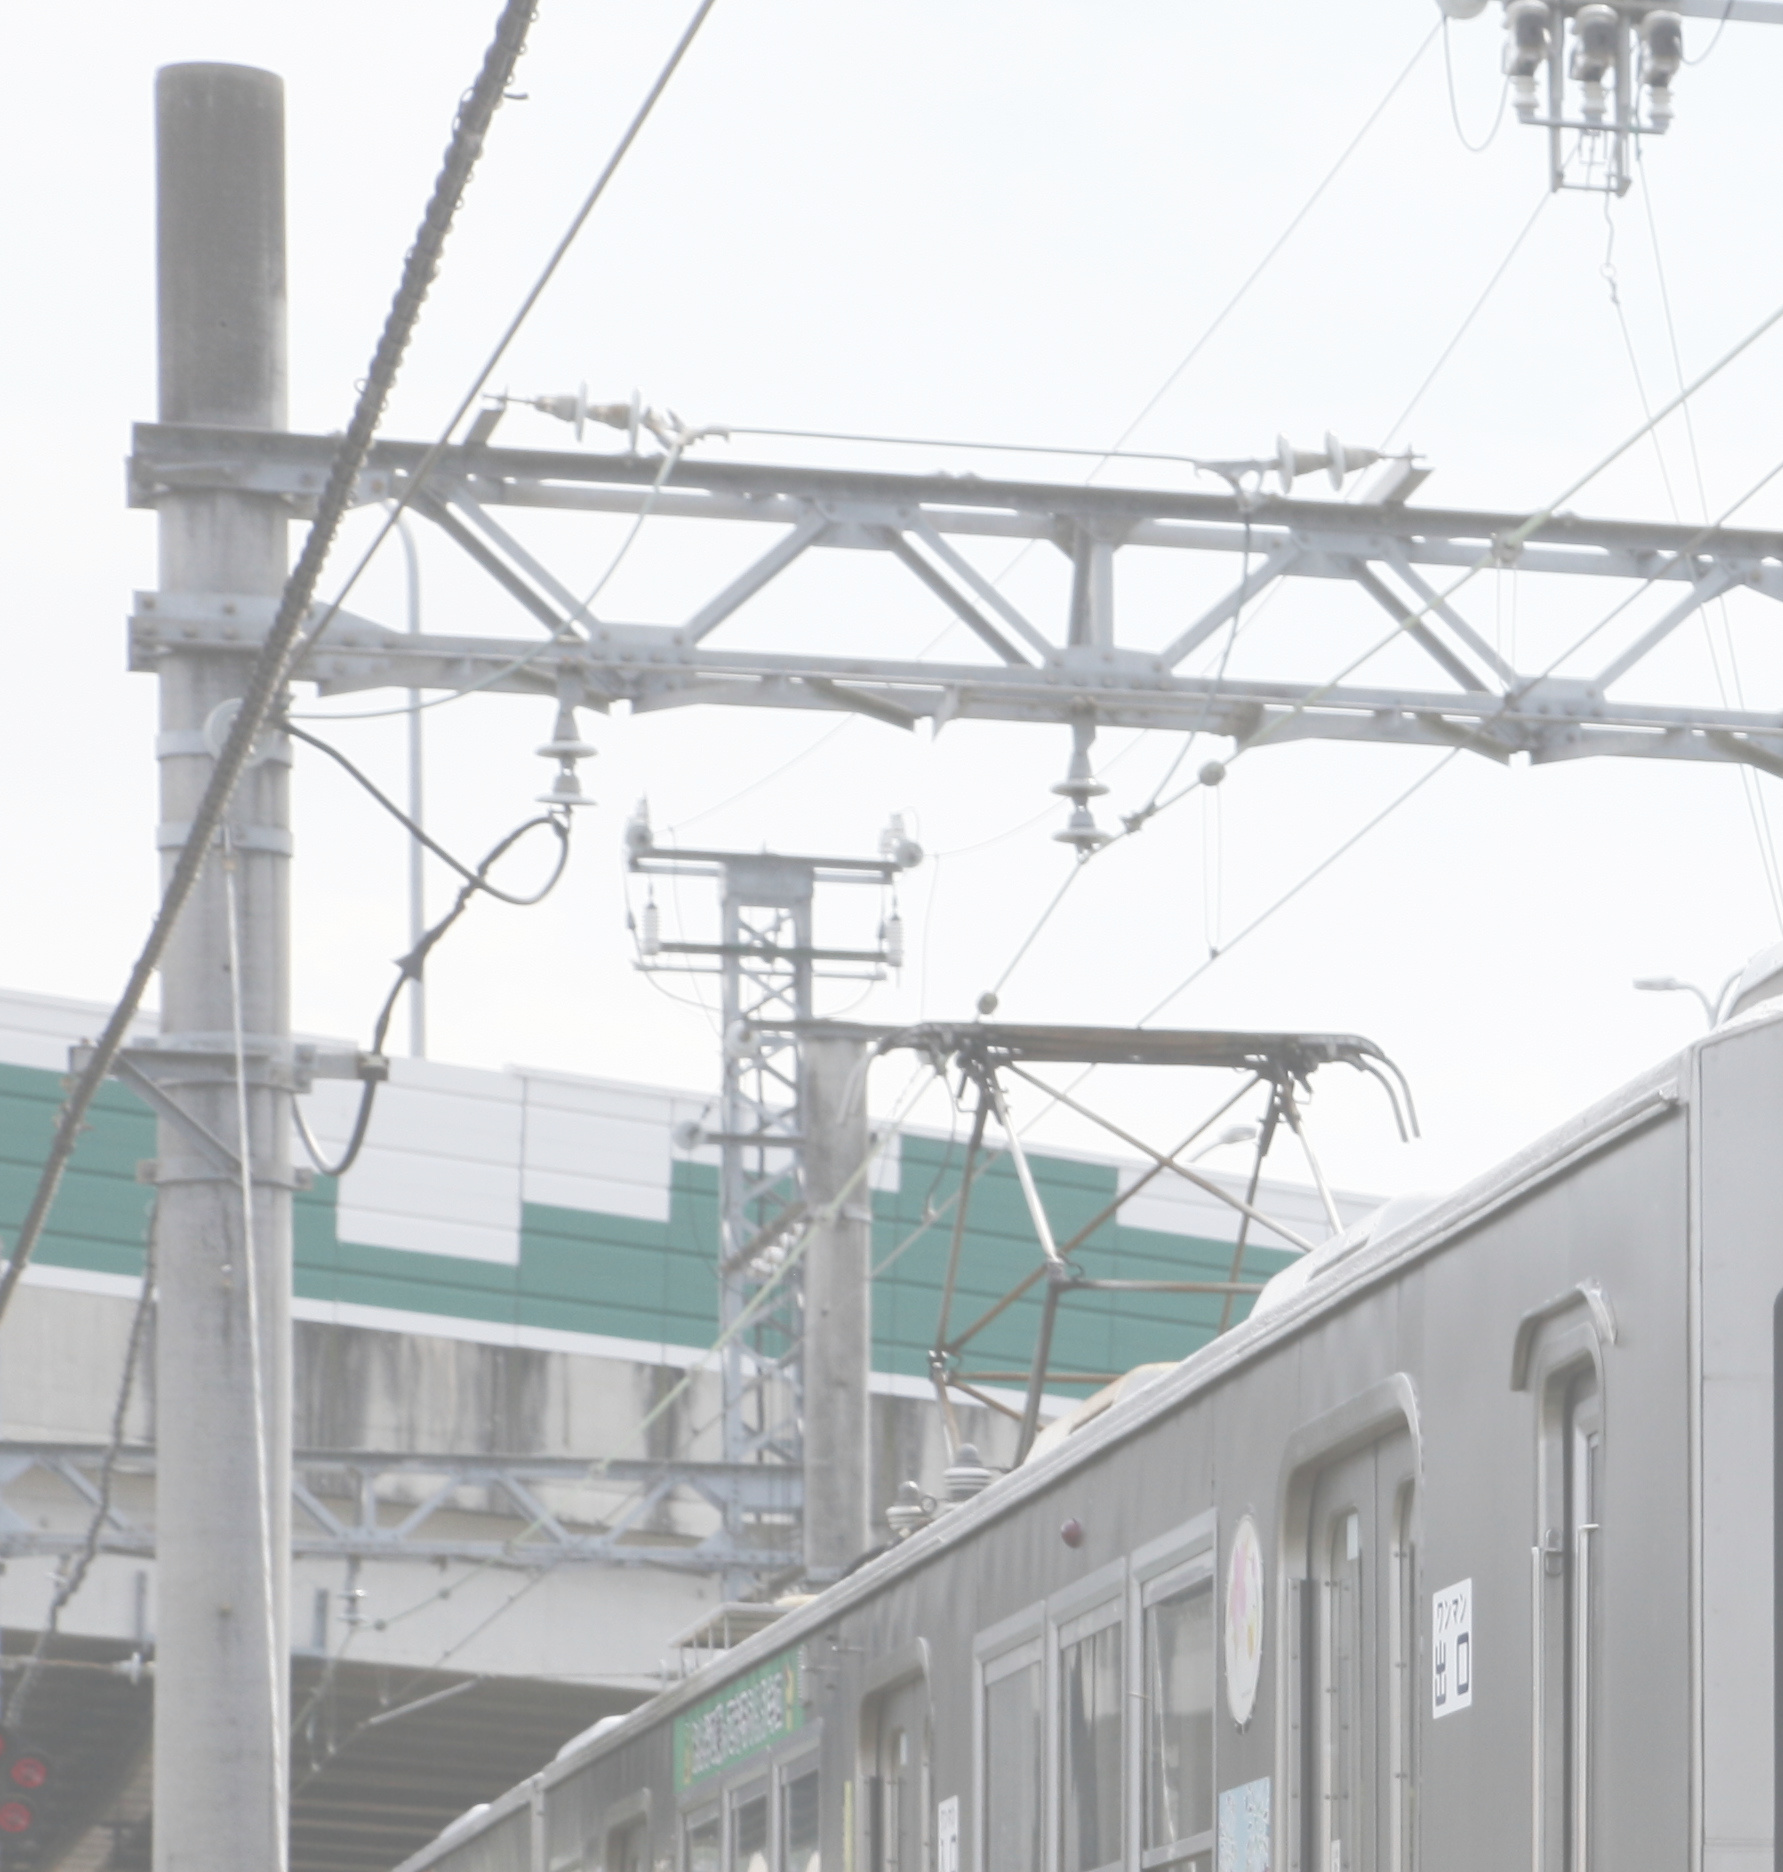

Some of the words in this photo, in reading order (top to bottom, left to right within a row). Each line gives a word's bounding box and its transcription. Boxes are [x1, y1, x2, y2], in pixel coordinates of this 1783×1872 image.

[1437, 1593, 1467, 1633] ワンマン
[1435, 1631, 1469, 1707] 出口
